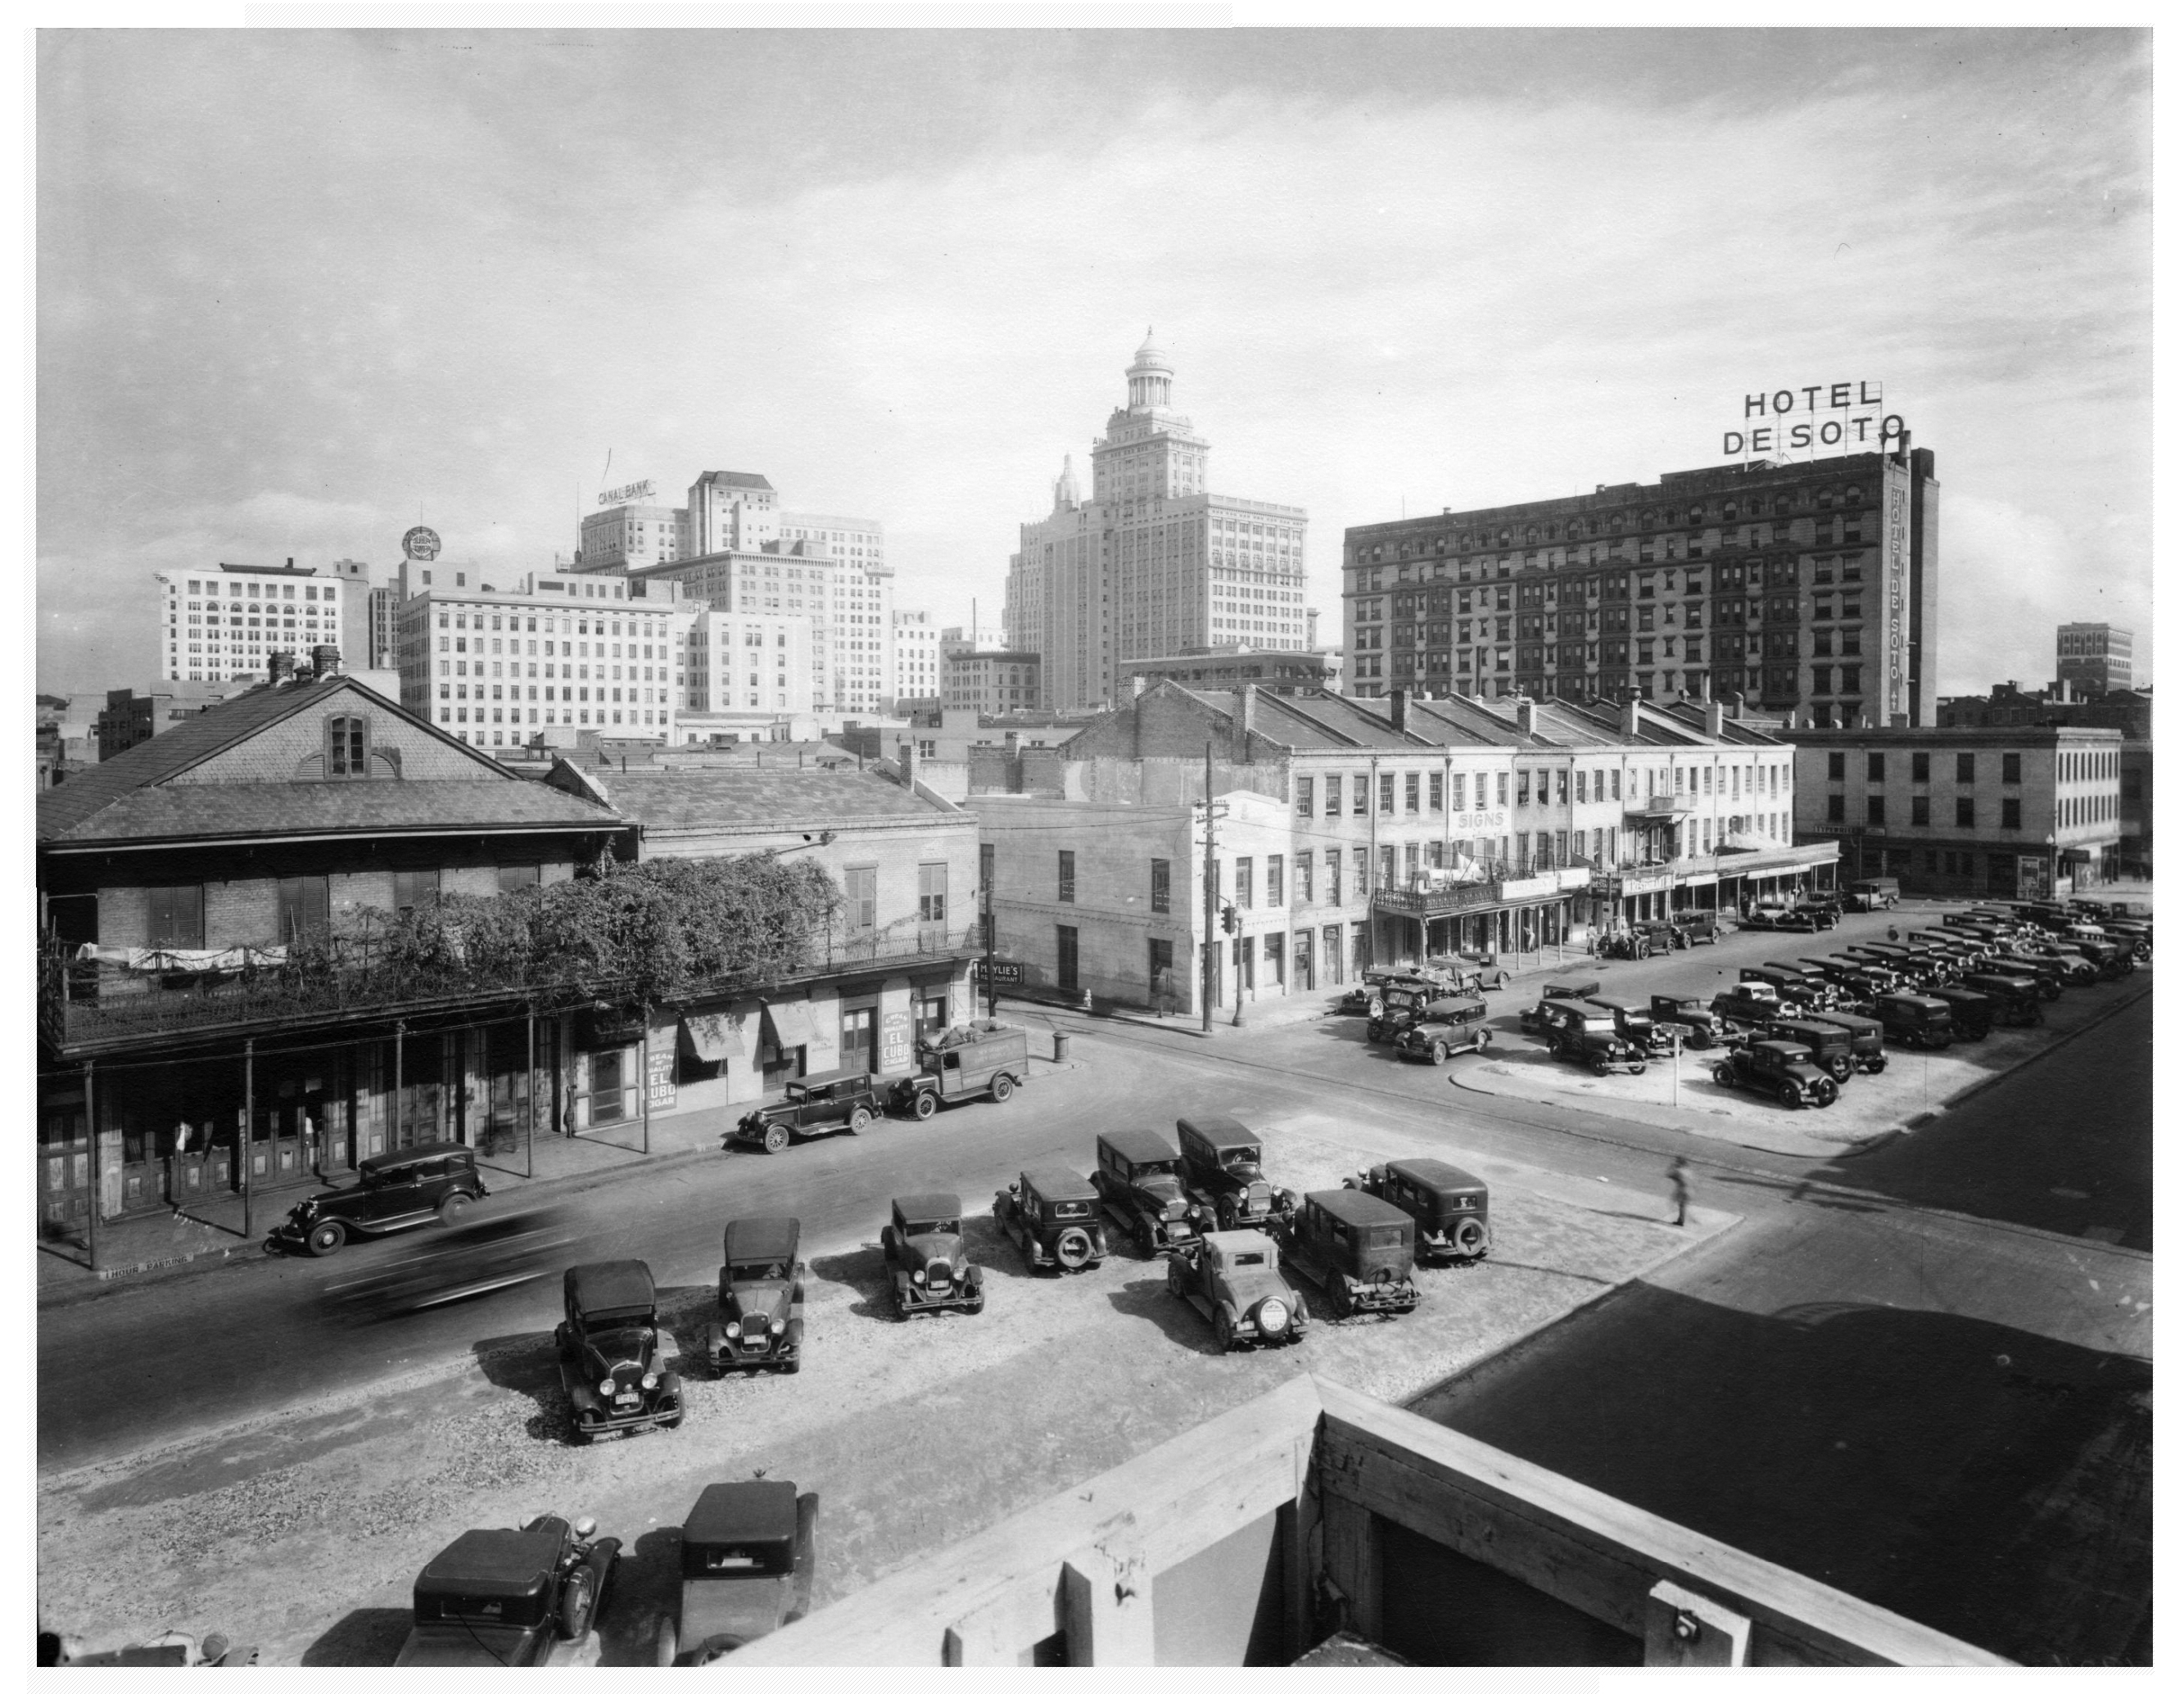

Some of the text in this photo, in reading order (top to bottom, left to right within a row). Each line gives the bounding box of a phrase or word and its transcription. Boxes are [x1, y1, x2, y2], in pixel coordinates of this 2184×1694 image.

[1745, 380, 1882, 418] HOTEL
[1723, 414, 1905, 455] DE SOTO
[599, 479, 649, 505] CANAL BANK
[1890, 491, 1901, 679] HOTEL DE SOTO
[1458, 811, 1504, 829] SIGNS
[1592, 880, 1622, 890] RESTAANT
[1631, 875, 1666, 893] RESTAURANT
[980, 964, 1018, 976] MYLIE'S
[980, 974, 1018, 983] REAURANT
[884, 1024, 909, 1034] QUALITY
[889, 1032, 904, 1045] EL
[648, 1053, 674, 1062] REAM
[884, 1043, 909, 1059] CUBO
[884, 1056, 909, 1067] CIGAR
[649, 1064, 675, 1073] UALITY
[651, 1073, 668, 1086] EL
[106, 1256, 188, 1279] 1 HOUR PARKING
